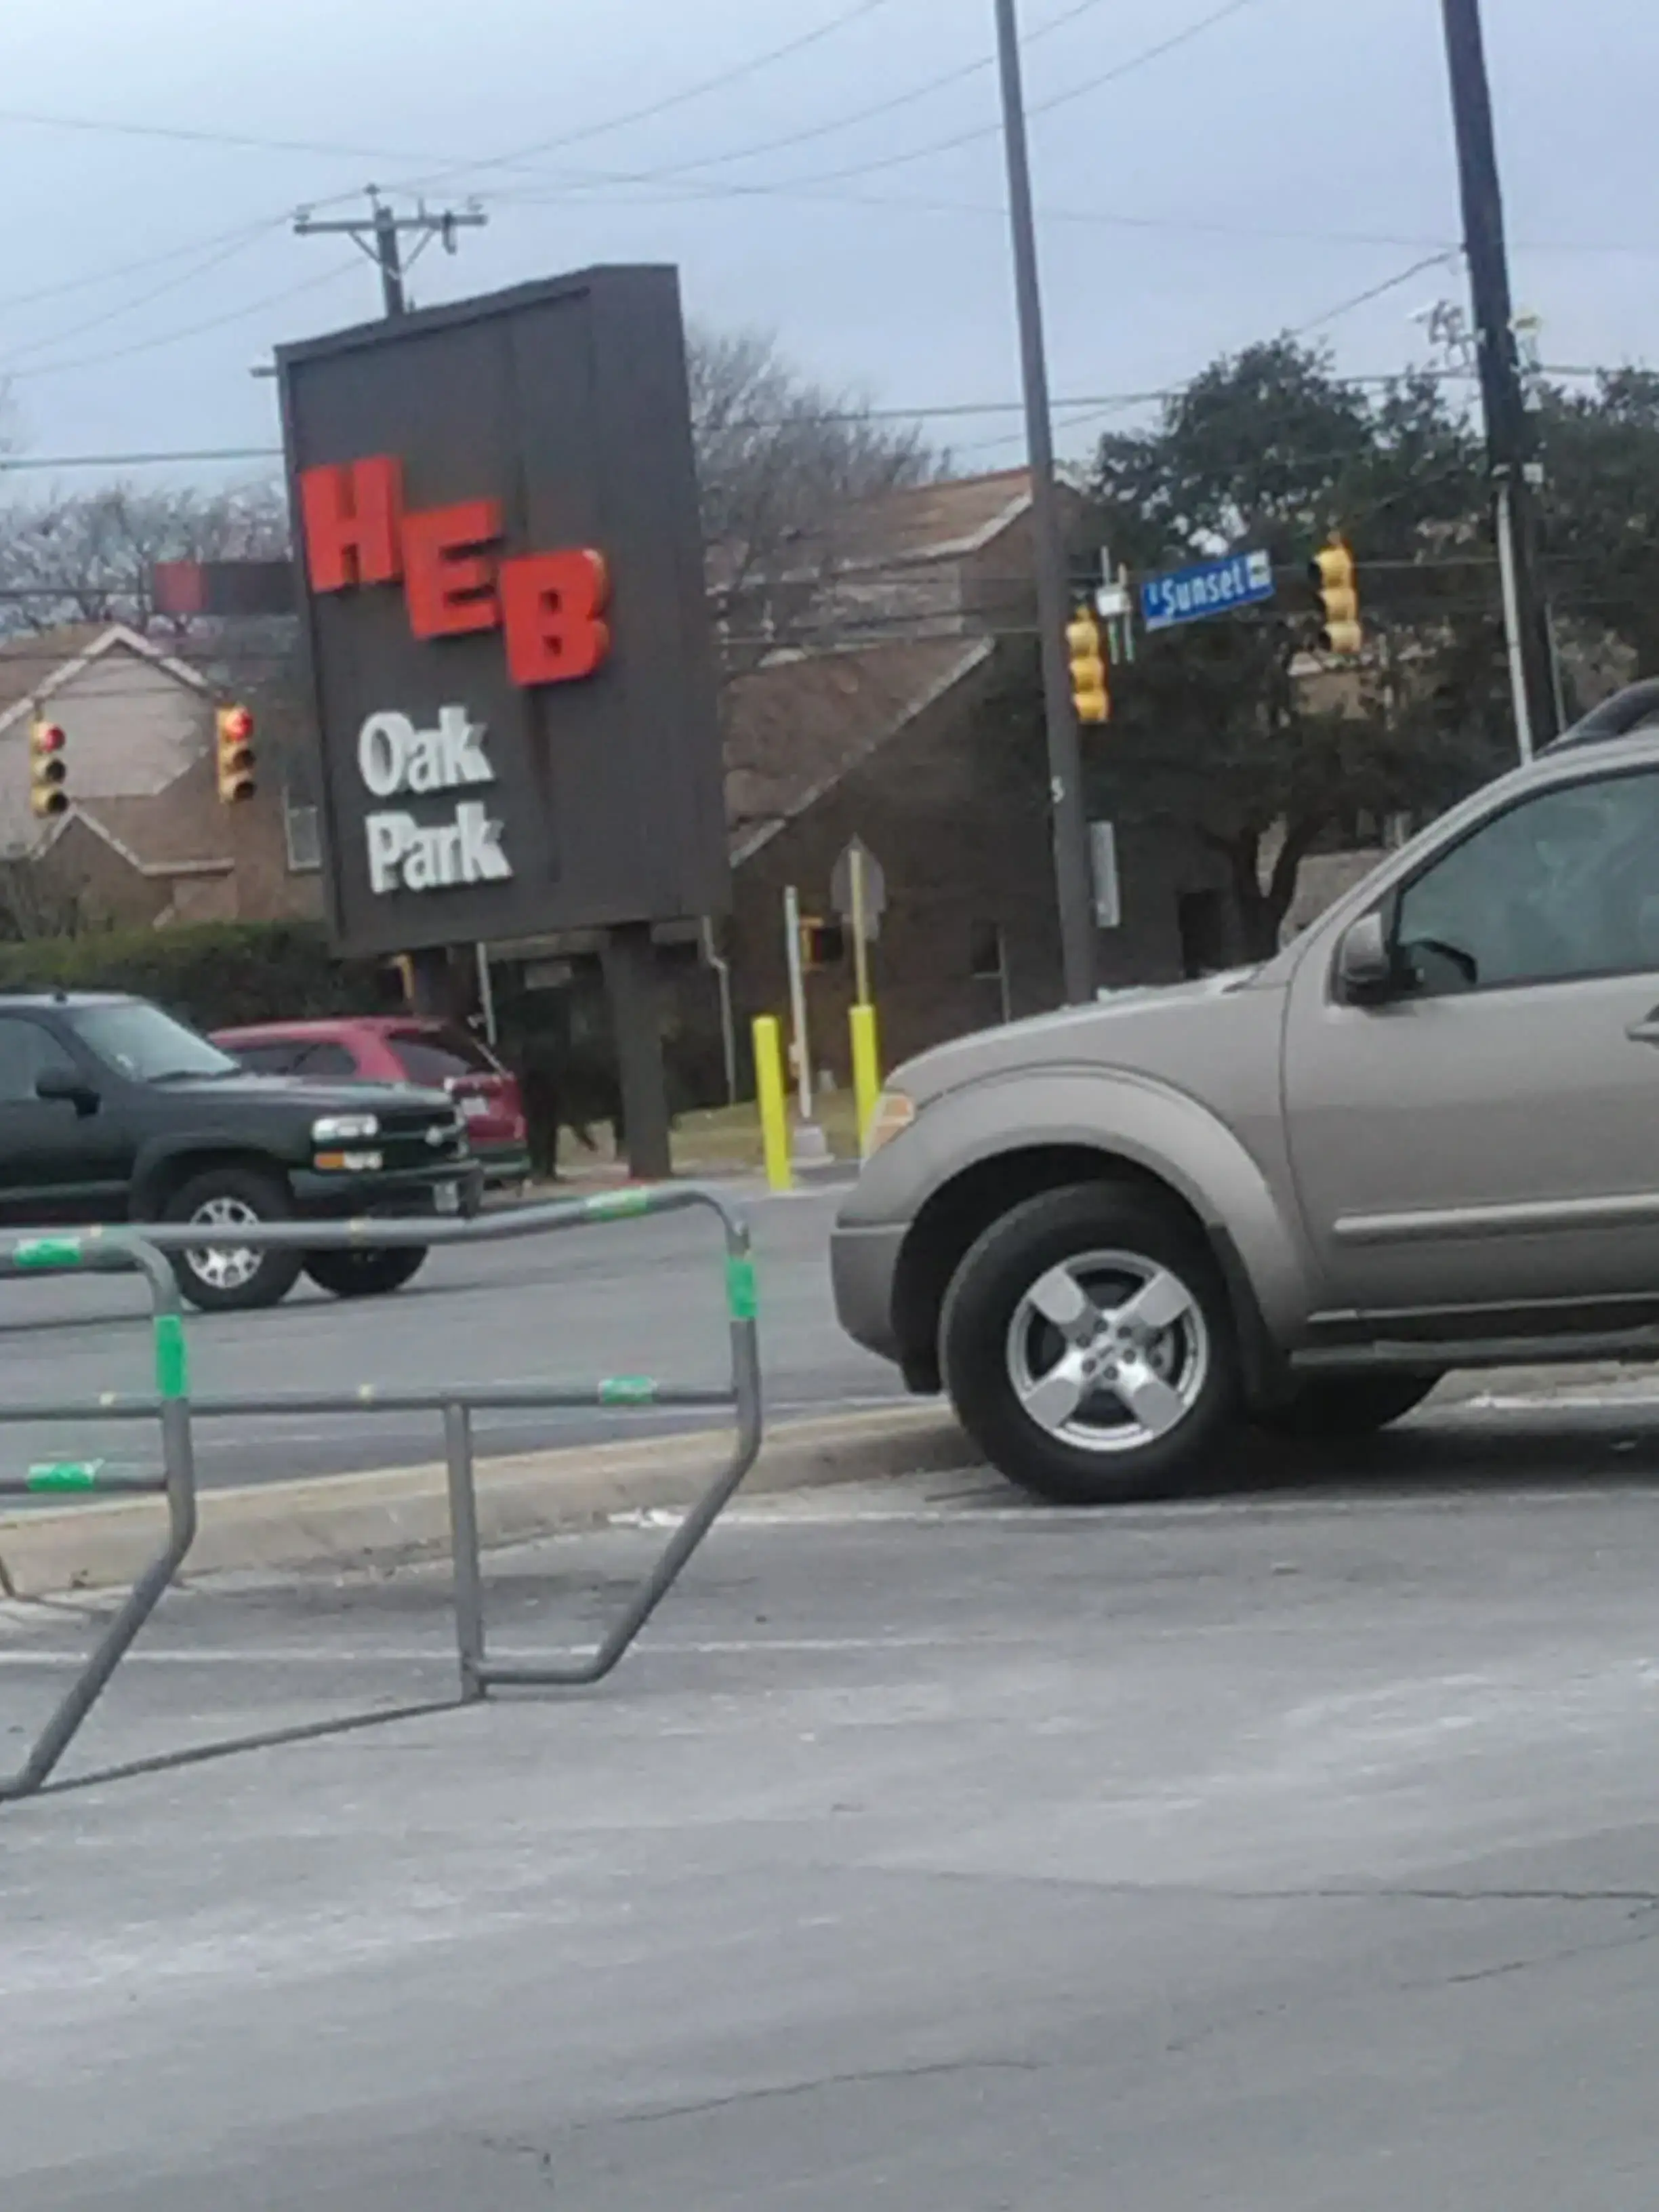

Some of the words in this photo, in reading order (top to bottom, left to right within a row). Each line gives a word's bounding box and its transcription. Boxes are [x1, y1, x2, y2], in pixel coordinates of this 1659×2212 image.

[302, 455, 611, 687] HEB
[1162, 560, 1246, 615] Sunset
[358, 705, 493, 796] Oak
[365, 802, 513, 893] Park
